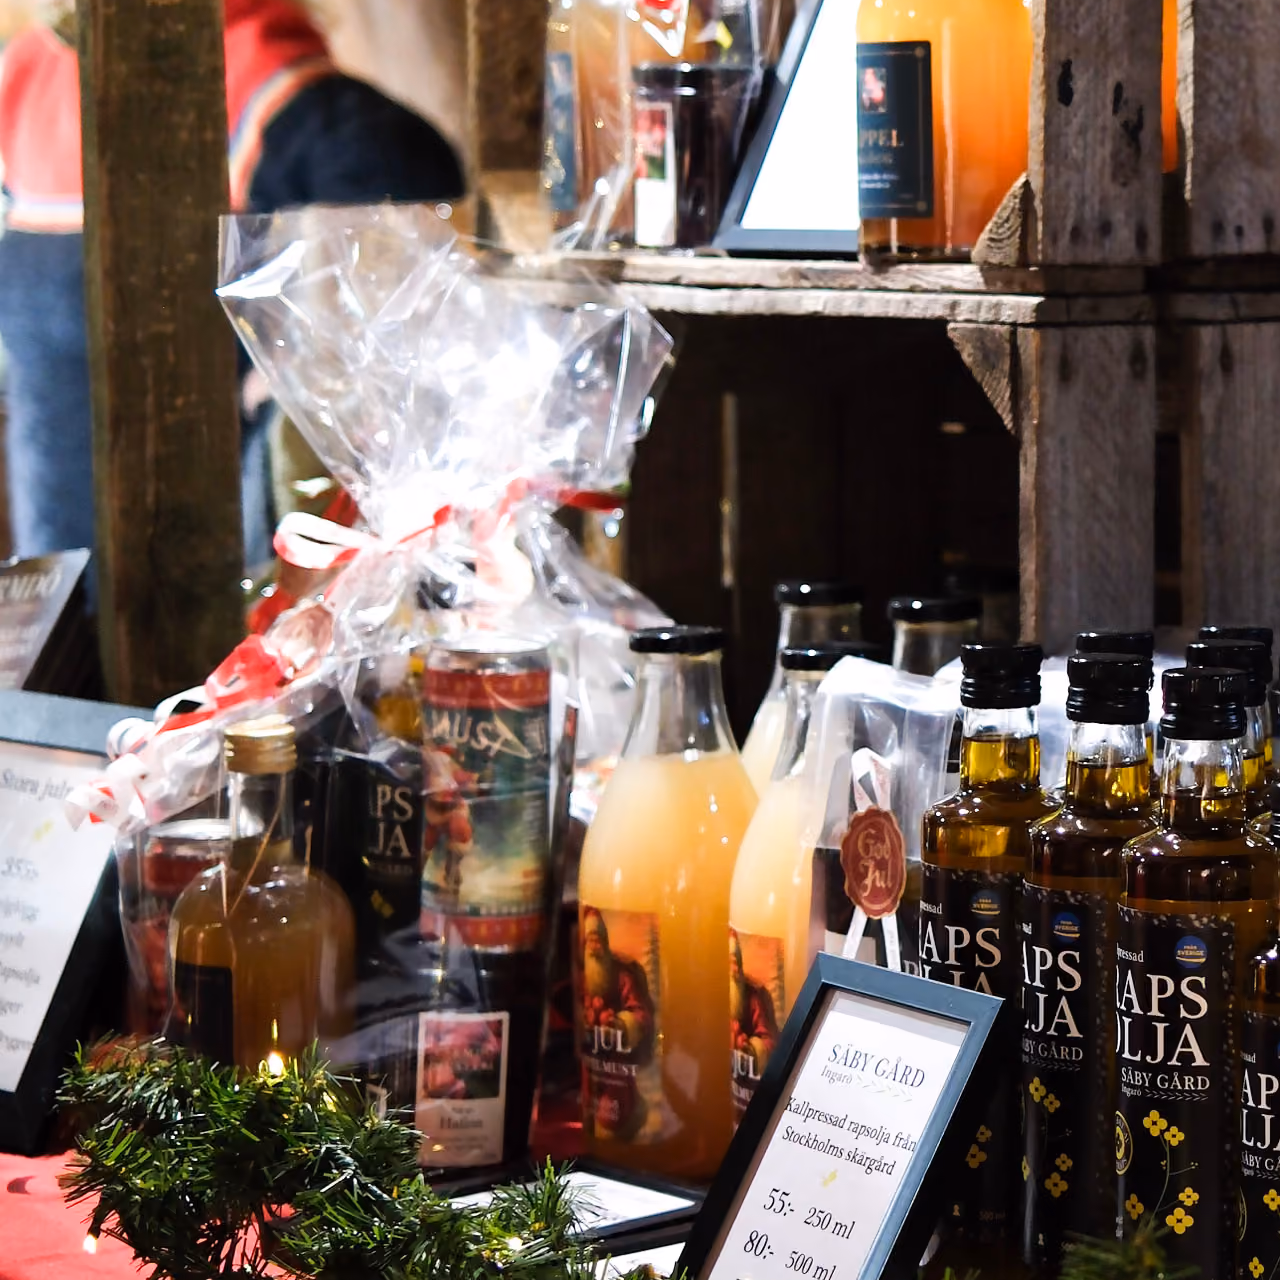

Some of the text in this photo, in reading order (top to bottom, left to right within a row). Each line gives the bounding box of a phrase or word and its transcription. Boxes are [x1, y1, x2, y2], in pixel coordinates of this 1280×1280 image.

[372, 784, 414, 822] PS
[857, 825, 892, 860] God
[858, 859, 893, 898] Jul
[919, 917, 1002, 968] APS
[1115, 964, 1209, 1020] APS
[590, 1025, 633, 1055] JUL
[1037, 1042, 1084, 1061] GÅRD
[731, 1048, 761, 1081] JUL
[820, 1064, 853, 1085] Ingarö
[828, 1043, 926, 1089] SÄBY GÅRD
[1121, 1066, 1211, 1091] SÄBY GÅRD
[784, 1095, 917, 1152] Kallpressad rapsolja från
[781, 1125, 897, 1176] Stockholms skärgård
[763, 1187, 856, 1240] 55:- 250 ml
[743, 1229, 775, 1260] 80:-
[784, 1250, 814, 1275] 500
